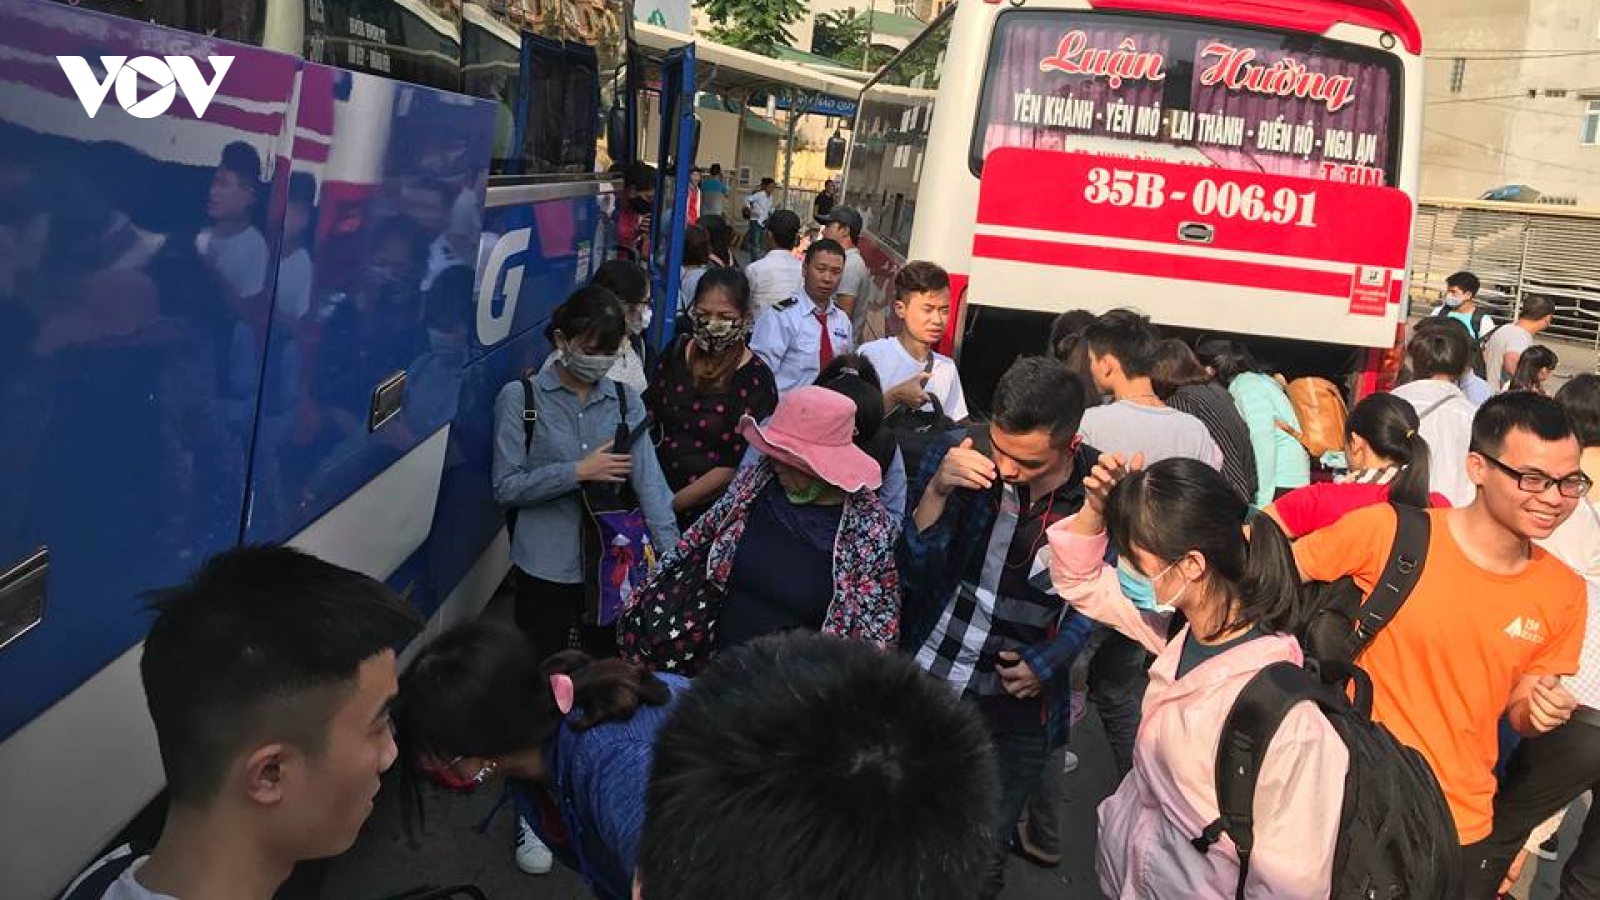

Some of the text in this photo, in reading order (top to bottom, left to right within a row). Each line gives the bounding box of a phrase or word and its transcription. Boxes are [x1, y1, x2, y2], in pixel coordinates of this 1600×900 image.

[1040, 30, 1355, 112] Luận Hường
[1013, 88, 1042, 123] YÊN
[1043, 92, 1094, 129] KHÁNH
[1106, 98, 1134, 133] YÊN
[1135, 101, 1161, 137] MÔ
[1171, 110, 1195, 141] LAI
[1293, 120, 1314, 161] HỘ
[1324, 129, 1354, 160] NGA
[1354, 133, 1377, 163] AN
[1084, 167, 1166, 208] 35B
[1192, 179, 1317, 227] 006.91
[476, 227, 532, 346] G
